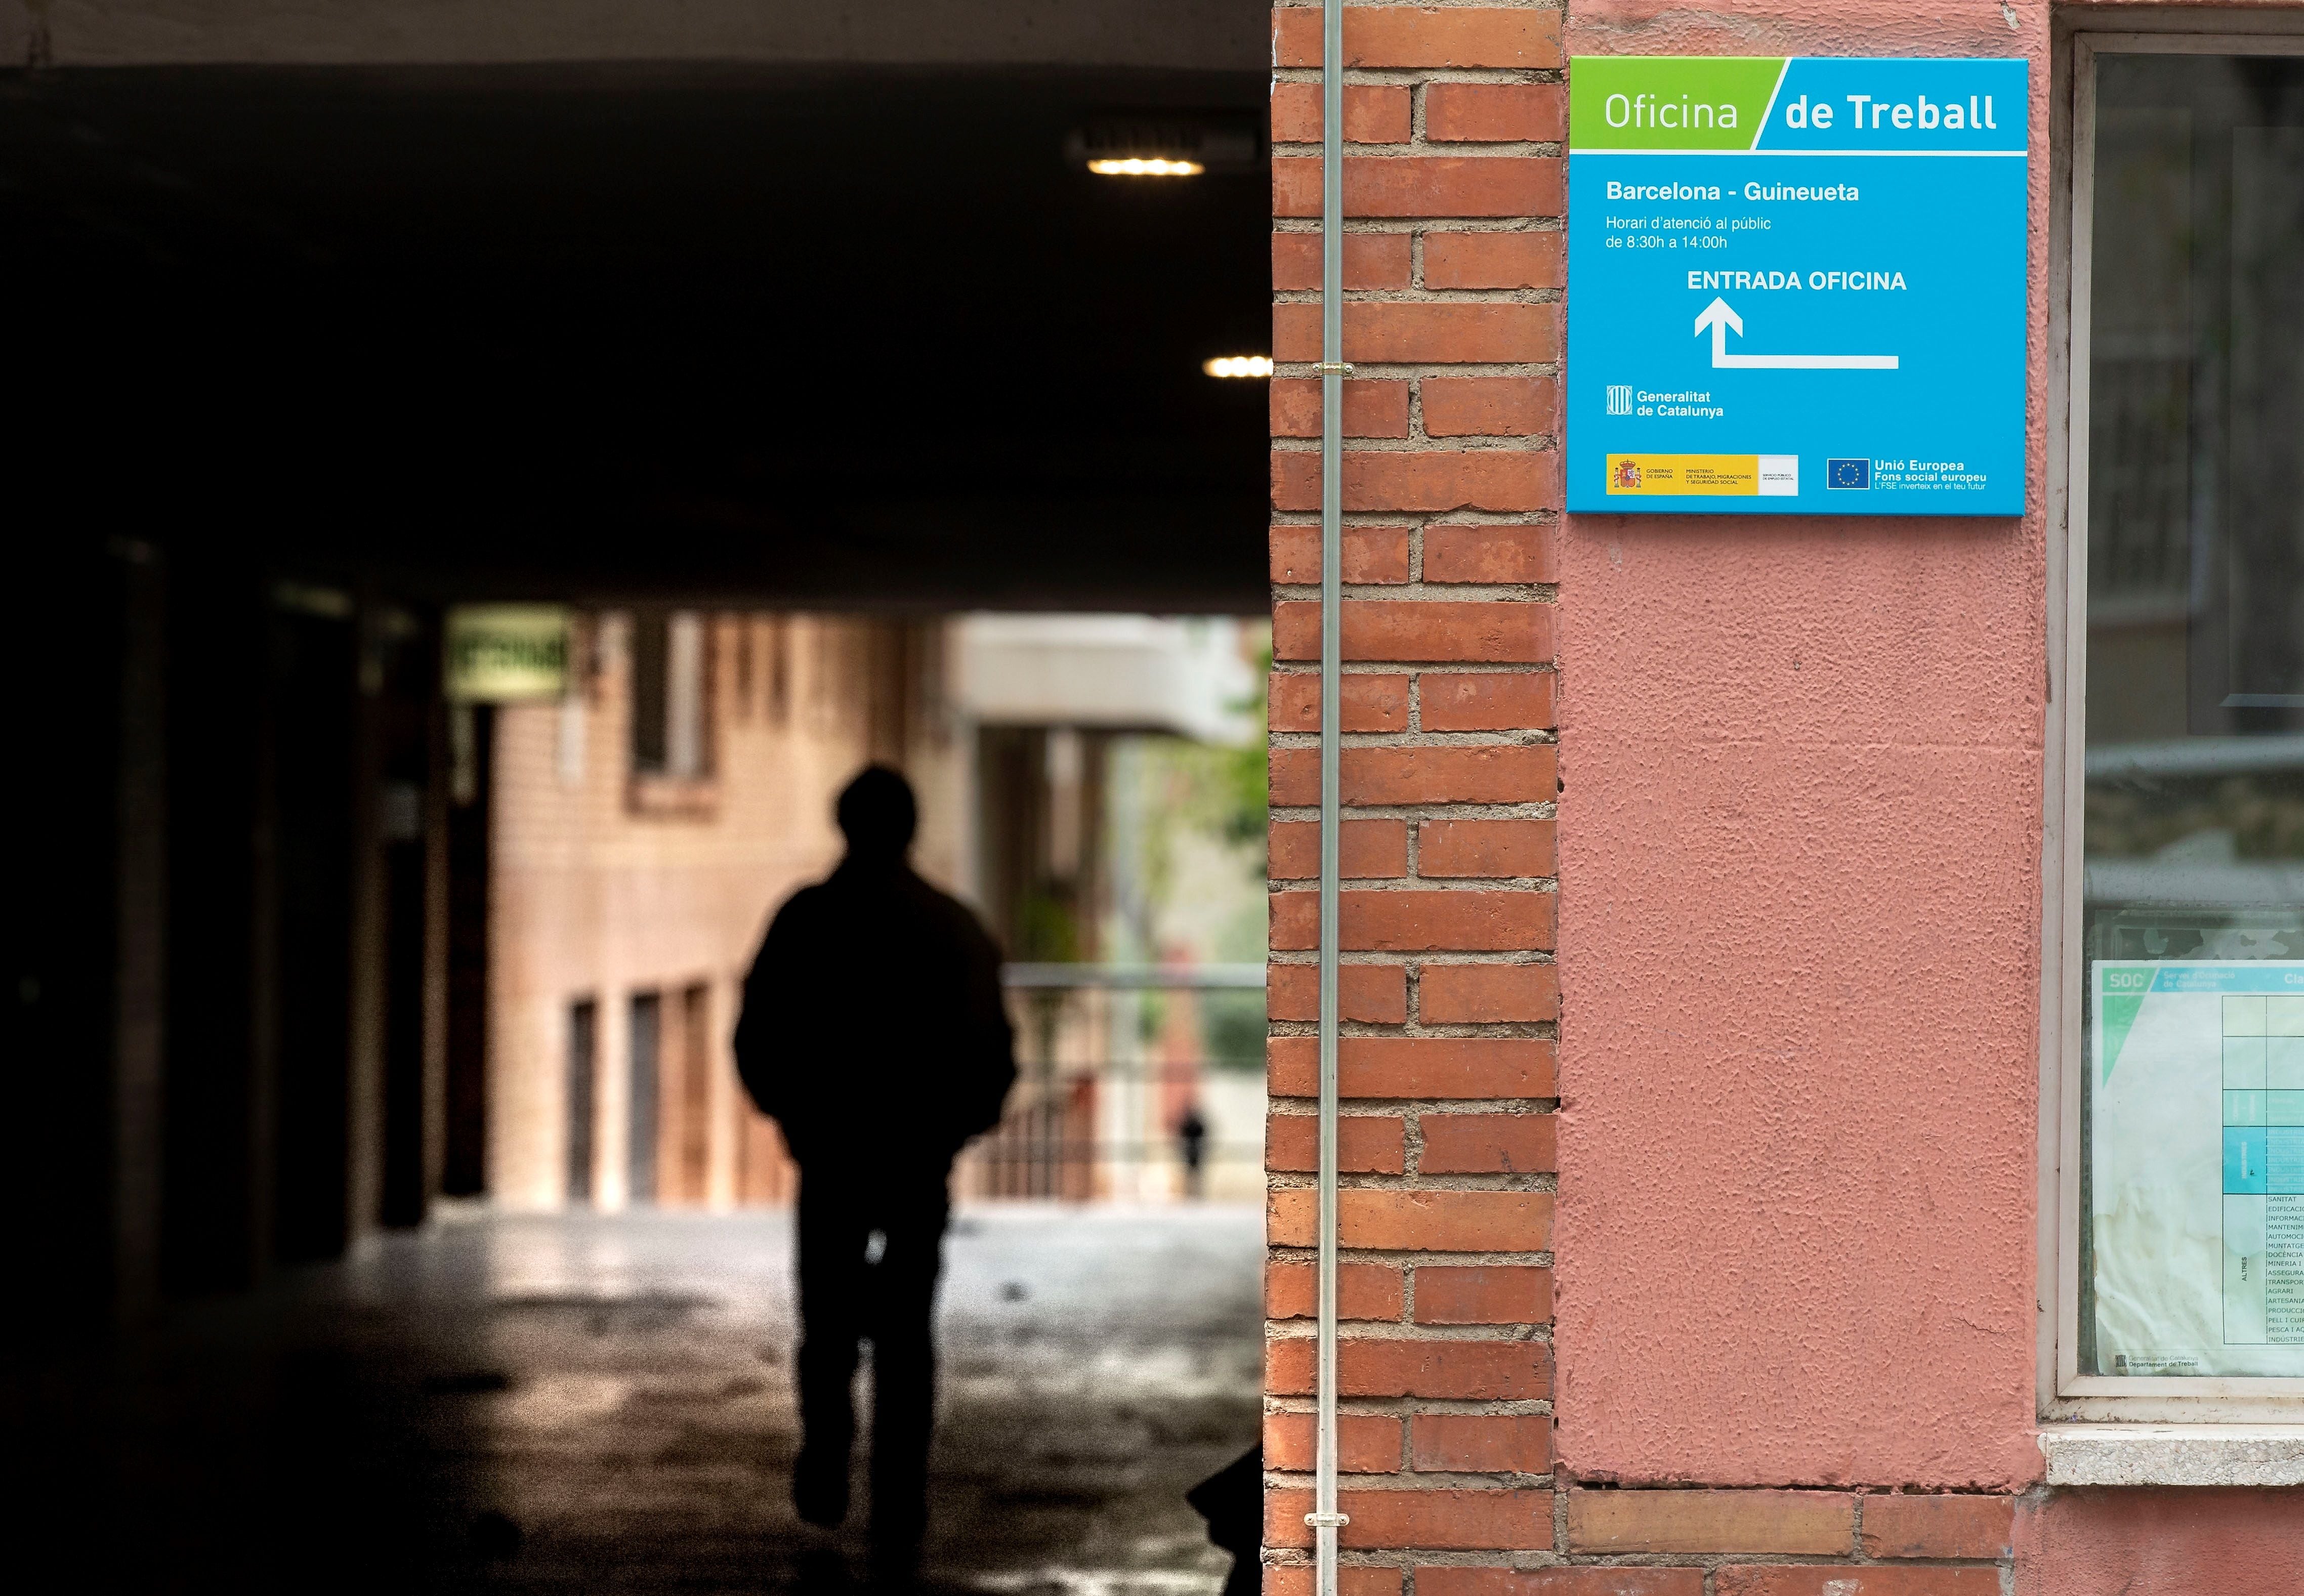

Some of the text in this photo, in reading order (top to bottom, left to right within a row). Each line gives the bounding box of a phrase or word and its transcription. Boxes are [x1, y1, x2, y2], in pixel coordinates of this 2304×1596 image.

[1606, 94, 1996, 129] Oficina de Treball
[1607, 181, 1720, 200] Barcelona
[1744, 182, 1858, 200] Guineueta
[1607, 217, 1646, 229] Horari
[1716, 217, 1727, 229] al
[1732, 217, 1771, 232] públic
[1606, 235, 1727, 248] de 8:30h a 14:00h
[1688, 271, 1907, 290] ENTRADA OFICINA
[1637, 391, 1710, 402] Generalitat
[1637, 405, 1723, 419] de Catalunya
[1875, 460, 1963, 473] Unió Europea
[1875, 472, 1986, 484] Fons social europeu
[2110, 974, 2143, 987] SOC
[2284, 974, 2304, 984] Cla
